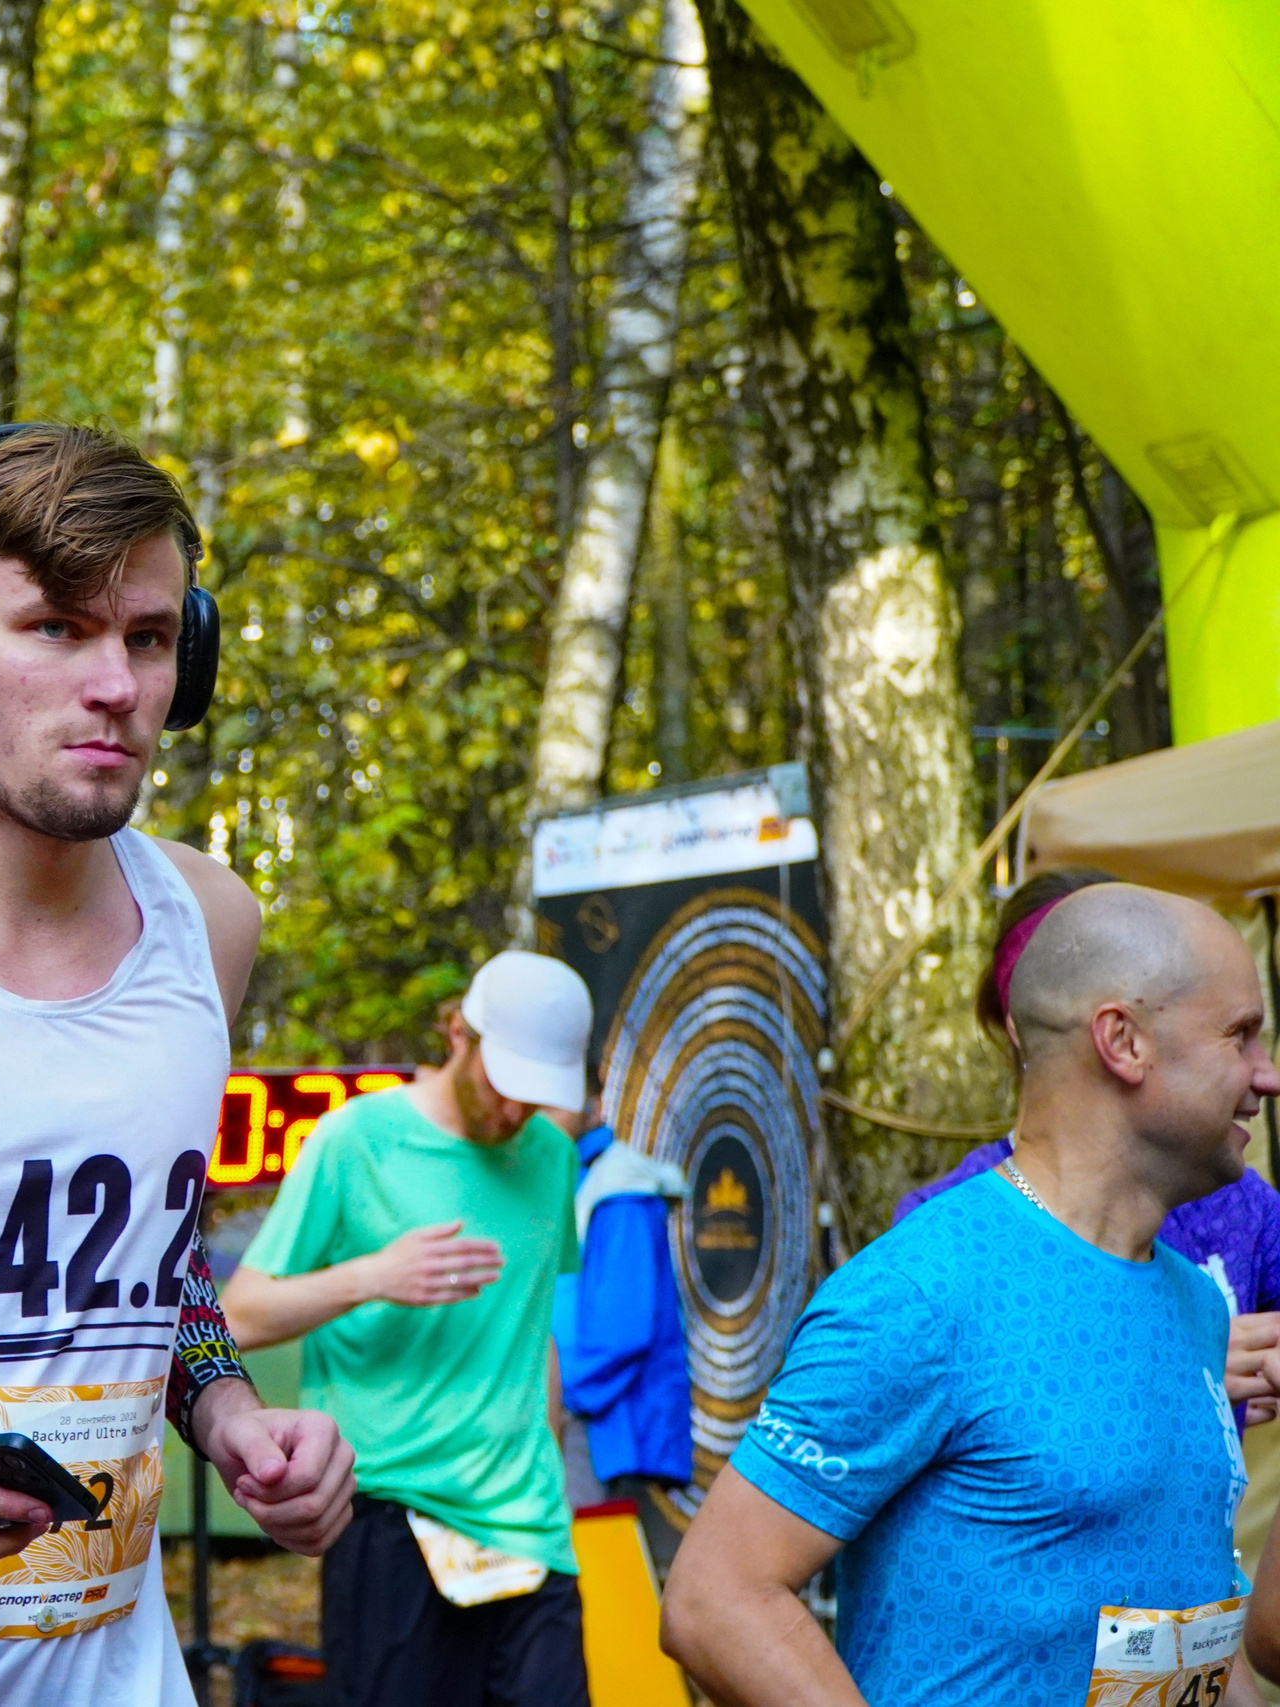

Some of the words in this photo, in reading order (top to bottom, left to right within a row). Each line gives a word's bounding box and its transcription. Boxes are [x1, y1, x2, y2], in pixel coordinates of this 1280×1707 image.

[59, 1416, 72, 1426] 28
[31, 1428, 90, 1444] Backyard
[95, 1426, 128, 1440] Ultra
[84, 1586, 109, 1603] PRO
[1192, 1633, 1228, 1652] Backyard
[1175, 1666, 1225, 1707] 45
